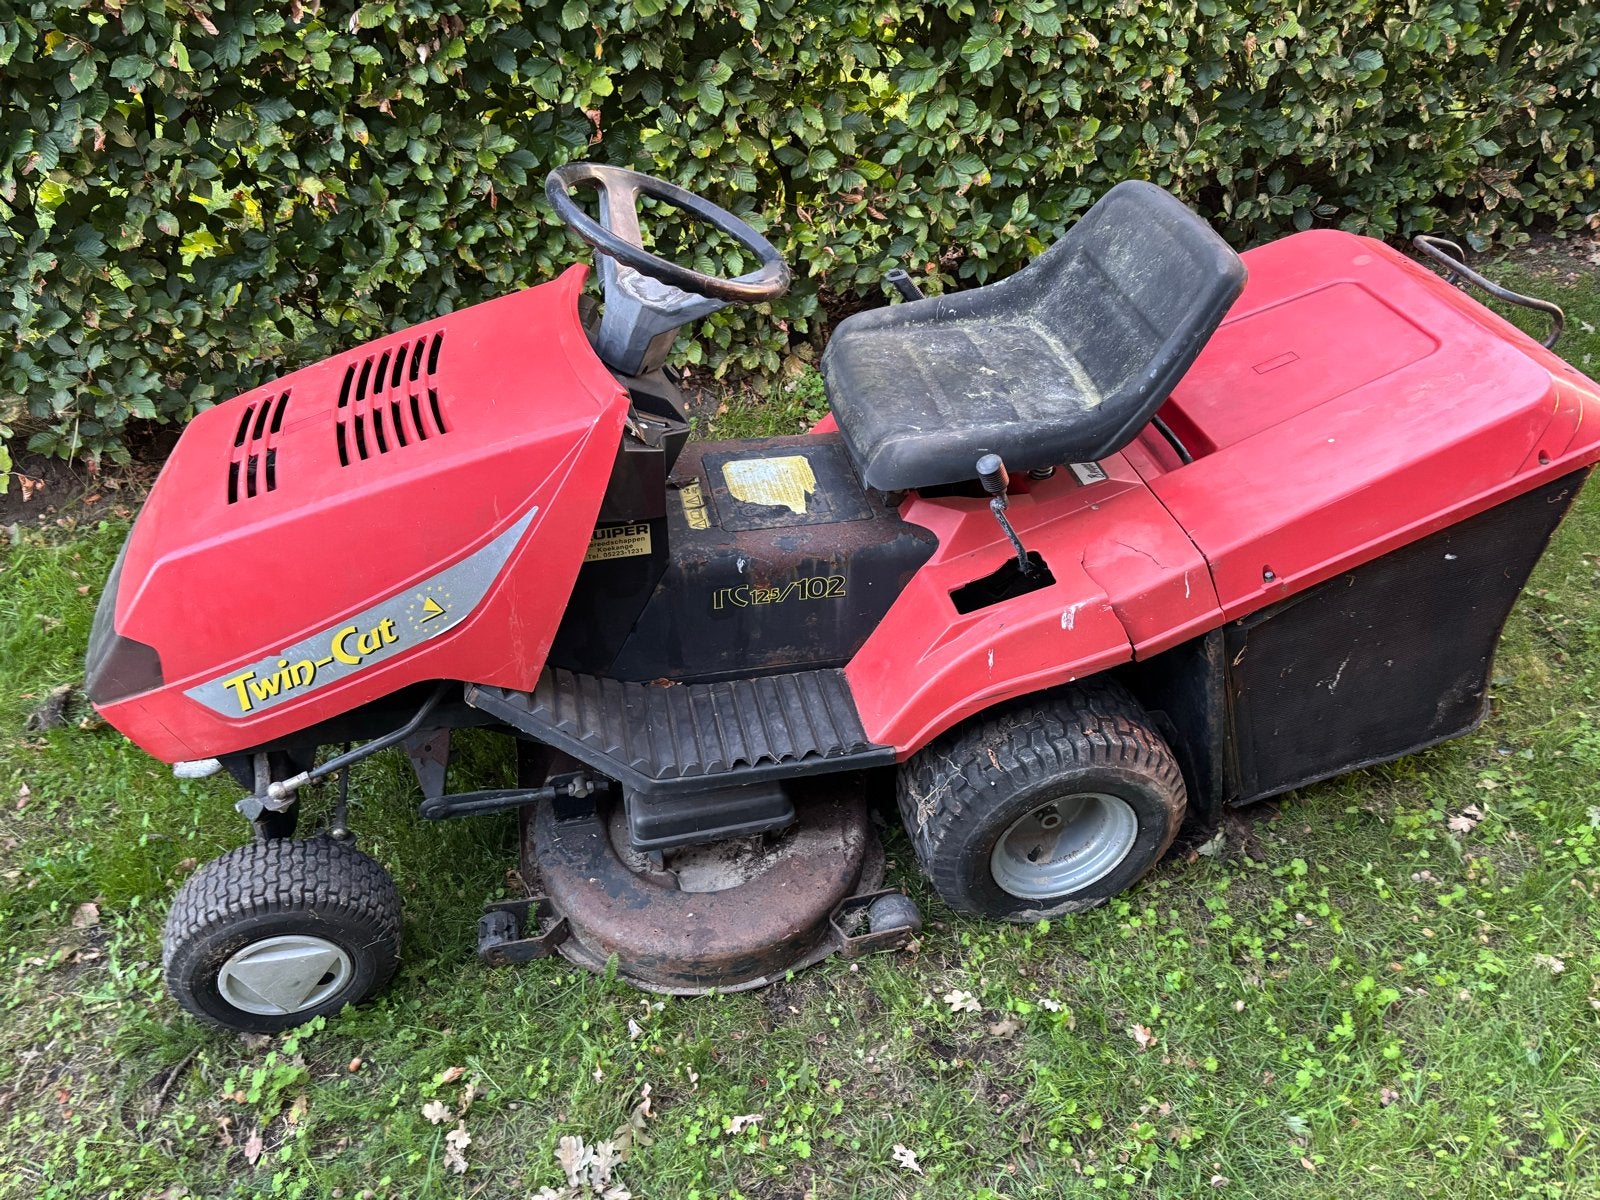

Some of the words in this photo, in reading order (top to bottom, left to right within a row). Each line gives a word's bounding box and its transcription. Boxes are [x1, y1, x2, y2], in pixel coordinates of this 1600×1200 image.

[590, 525, 648, 541] UIPER
[588, 537, 645, 548] ereedschappen
[597, 544, 634, 553] Koekange
[603, 548, 643, 558] 05223-1231
[222, 616, 399, 712] Twin-Cut
